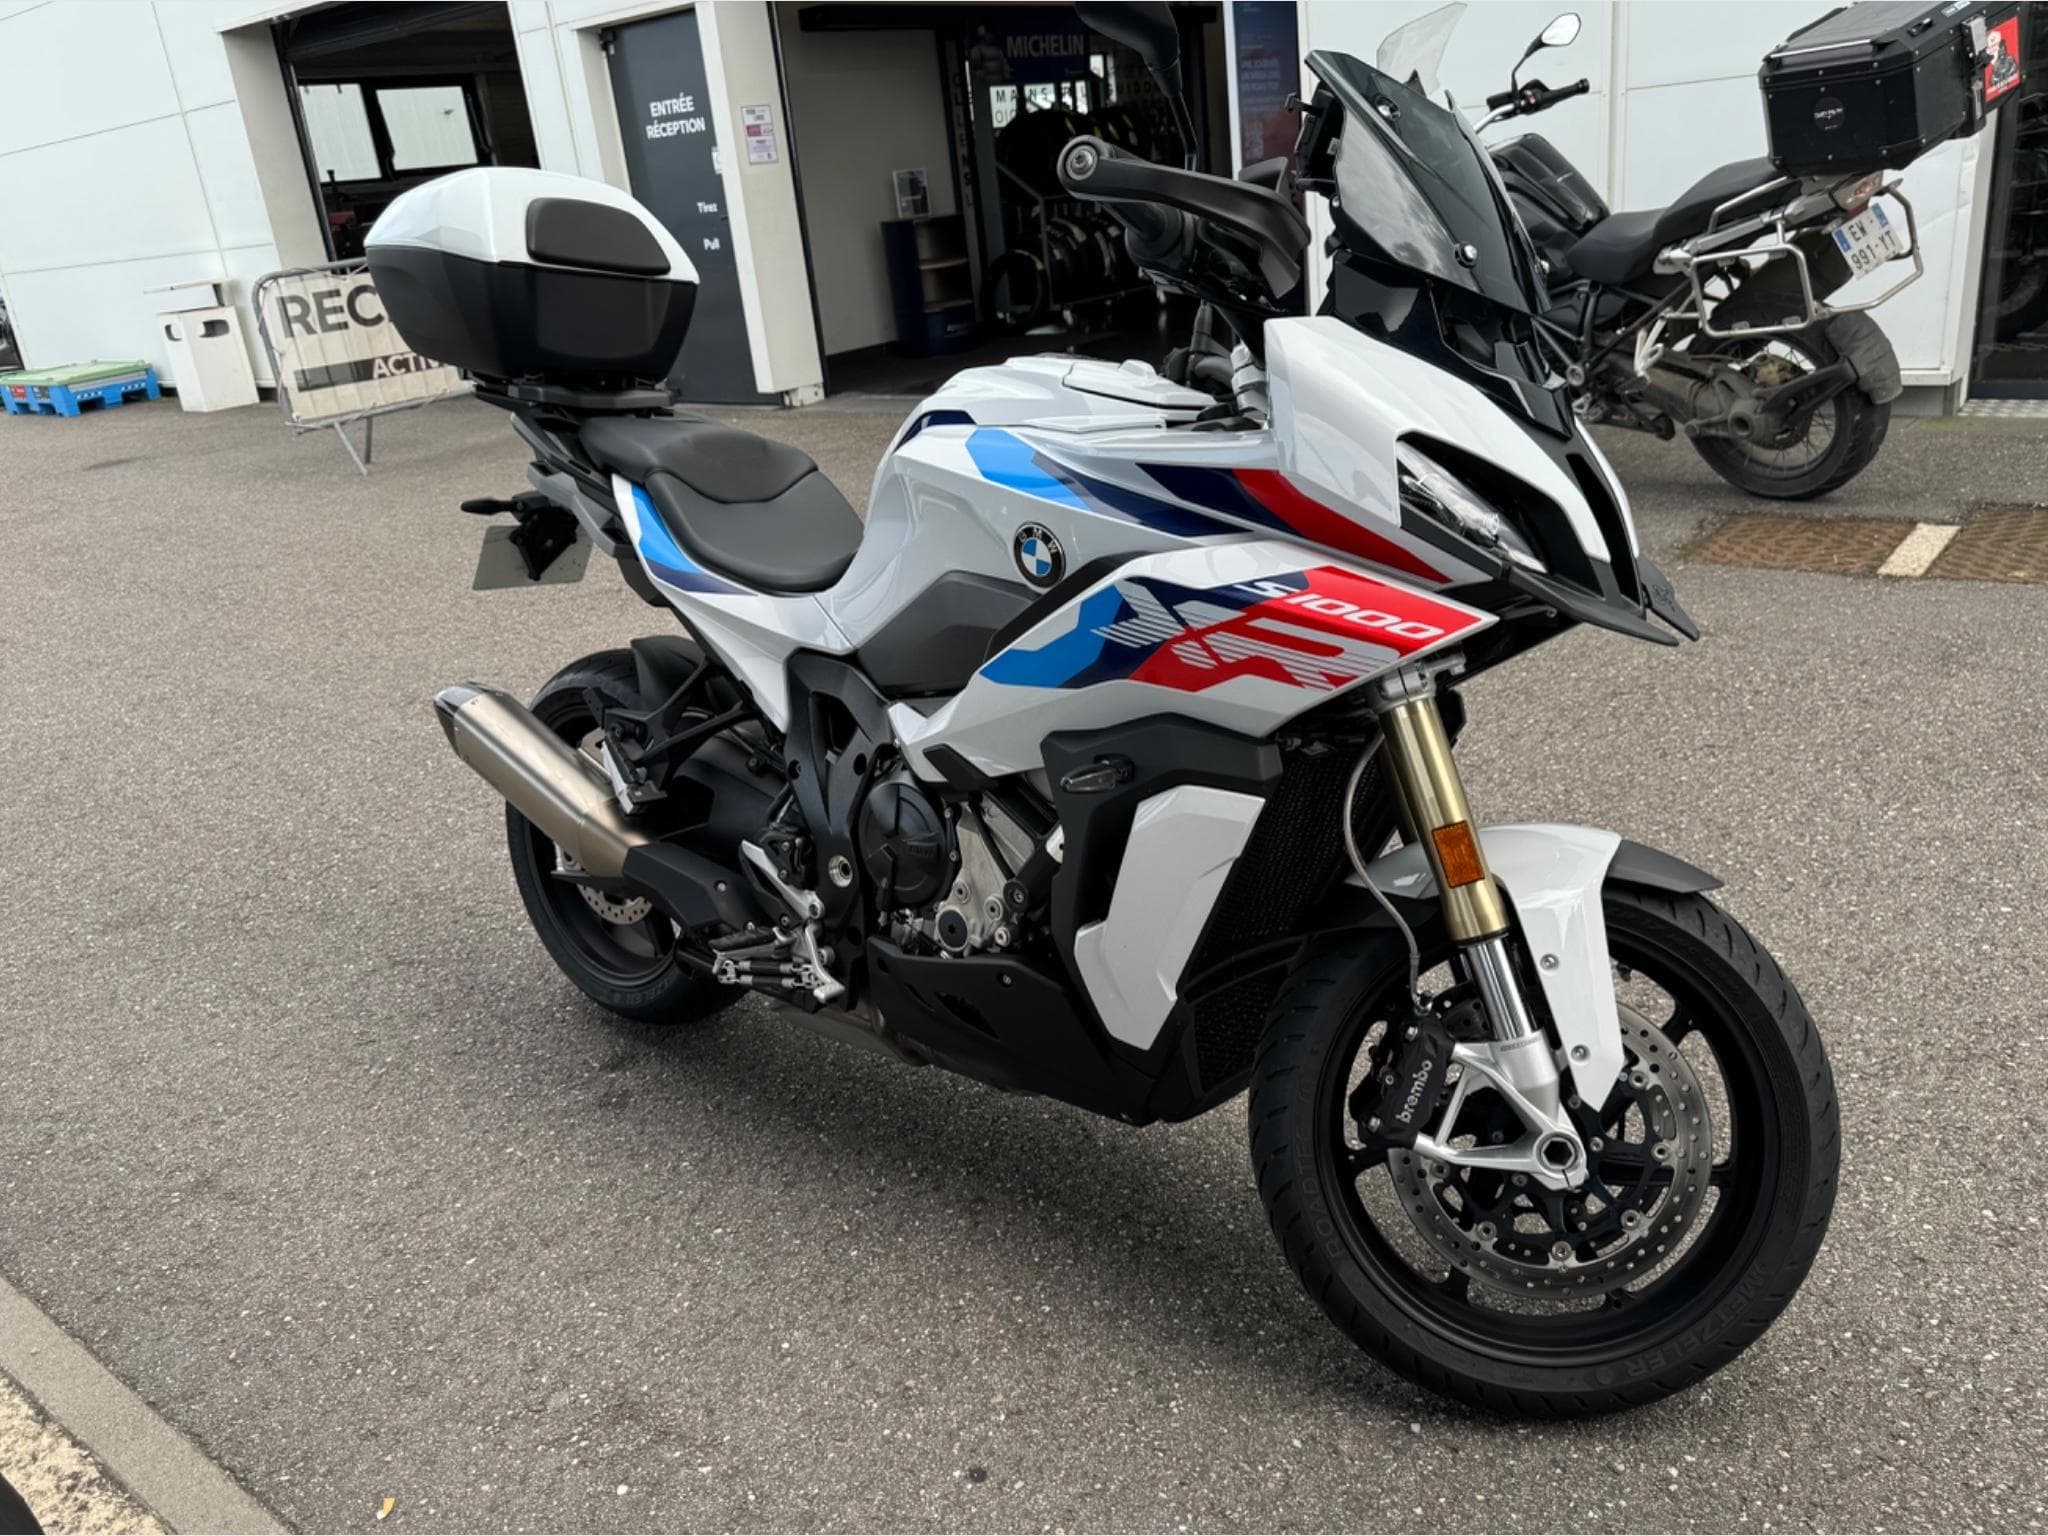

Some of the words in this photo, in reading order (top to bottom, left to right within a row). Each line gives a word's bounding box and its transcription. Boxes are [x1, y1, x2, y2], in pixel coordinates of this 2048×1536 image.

[1007, 34, 1085, 58] MICHELIN
[650, 92, 694, 117] ENTRÉE
[646, 117, 706, 138] RÉCEPTION
[703, 238, 720, 250] Pull
[1283, 593, 1446, 640] 1000
[1394, 1060, 1433, 1125] brembo
[1624, 1262, 1767, 1378] METZELER
